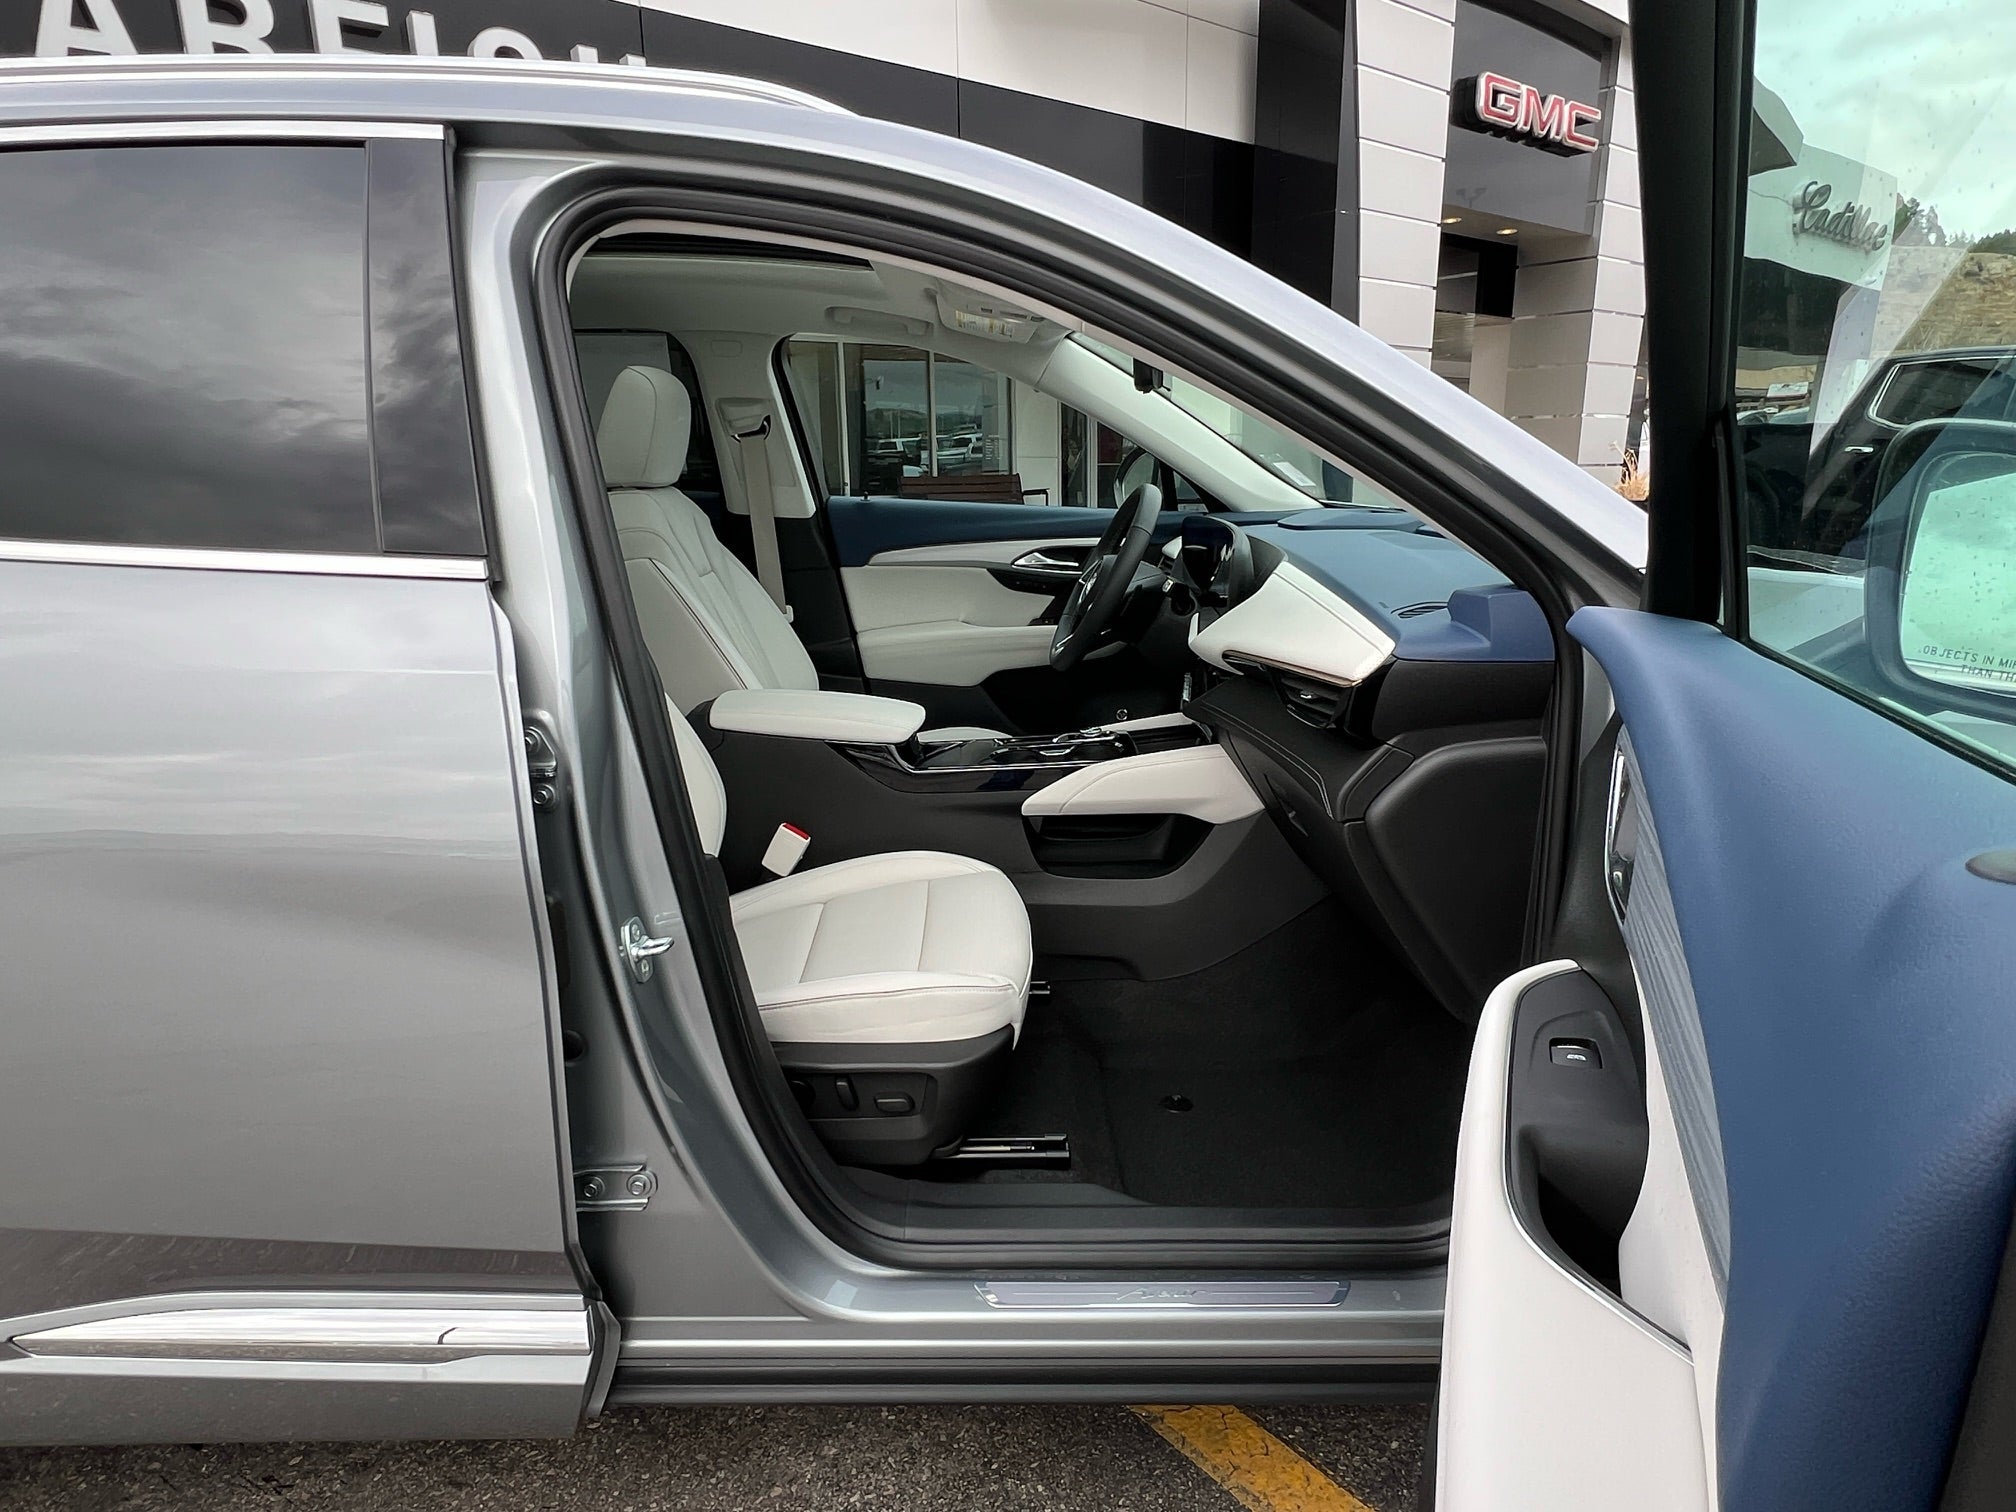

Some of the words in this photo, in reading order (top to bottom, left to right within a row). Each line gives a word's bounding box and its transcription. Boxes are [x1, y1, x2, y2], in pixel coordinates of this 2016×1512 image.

[1477, 71, 1602, 152] GMC
[1793, 180, 1888, 251] Cadillac
[1922, 645, 1979, 663] OBJECTS
[1982, 655, 1995, 665] IN
[1960, 664, 1992, 678] THAN
